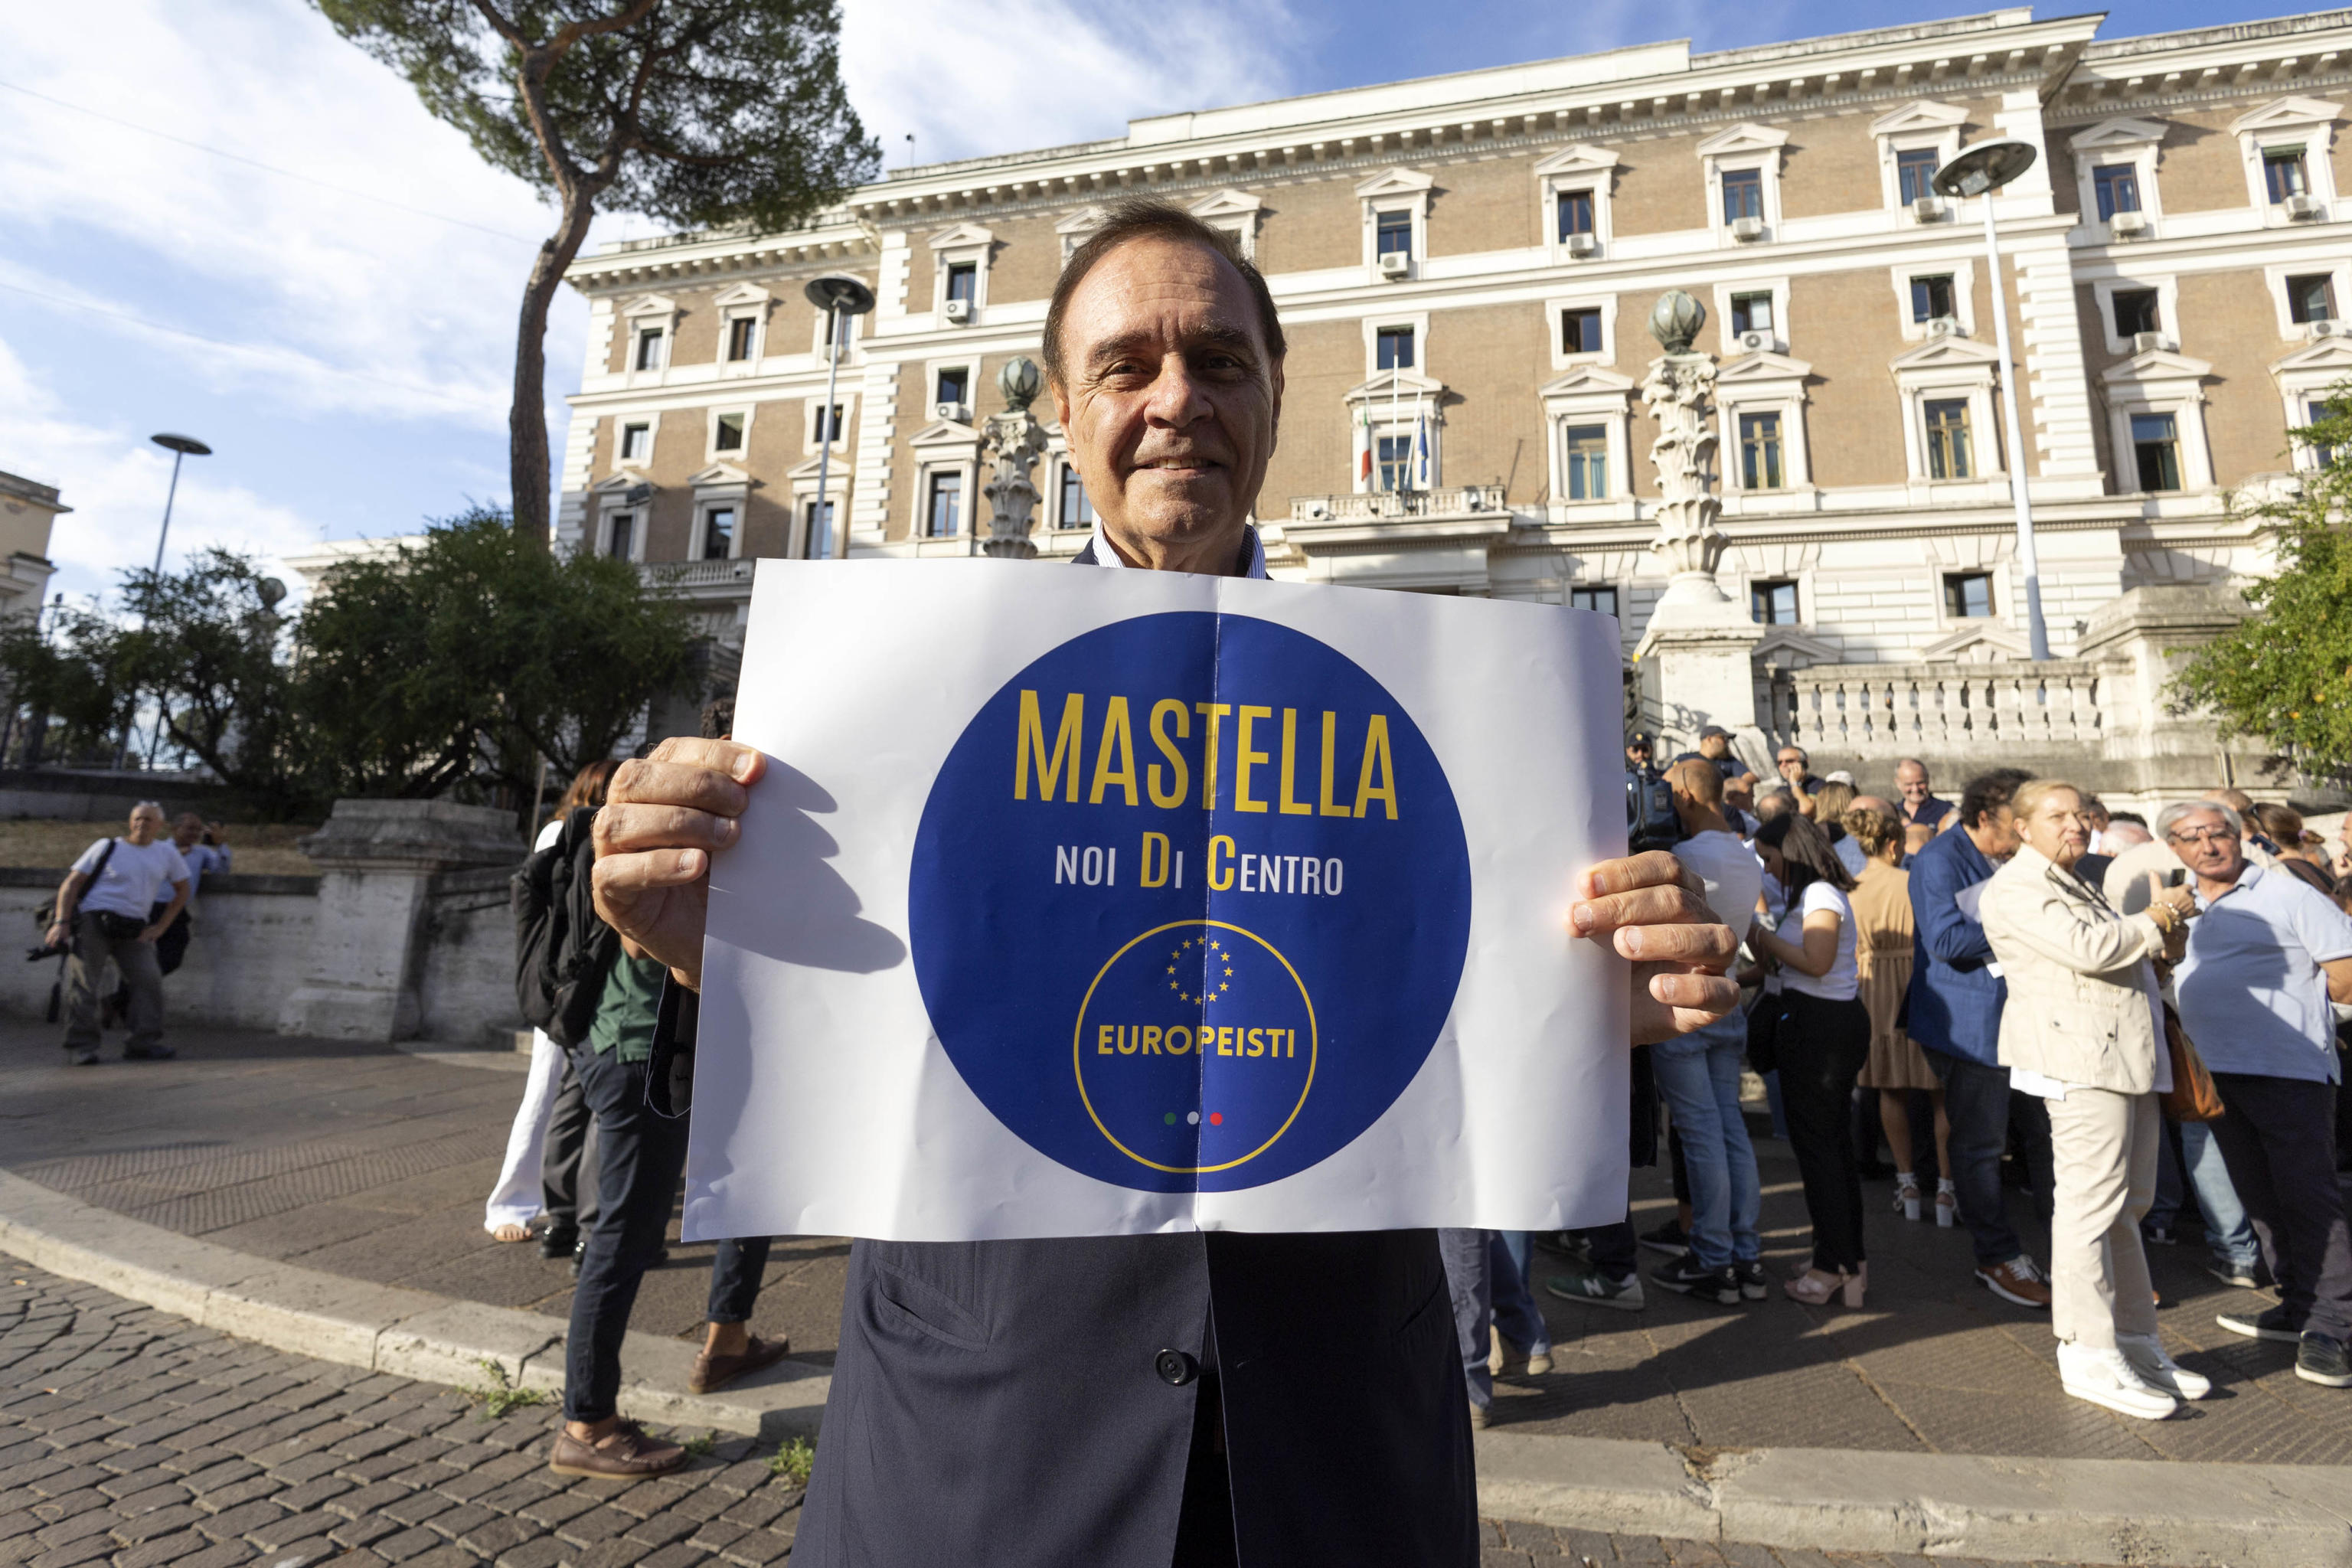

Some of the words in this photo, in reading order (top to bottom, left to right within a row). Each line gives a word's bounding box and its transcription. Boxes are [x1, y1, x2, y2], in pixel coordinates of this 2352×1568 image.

[1014, 689, 1399, 820] MASTELLA
[1055, 844, 1116, 887] NOI
[1140, 831, 1184, 889] DI
[1207, 835, 1344, 896] CENTRO
[1097, 1024, 1295, 1058] EUROPEISTI
